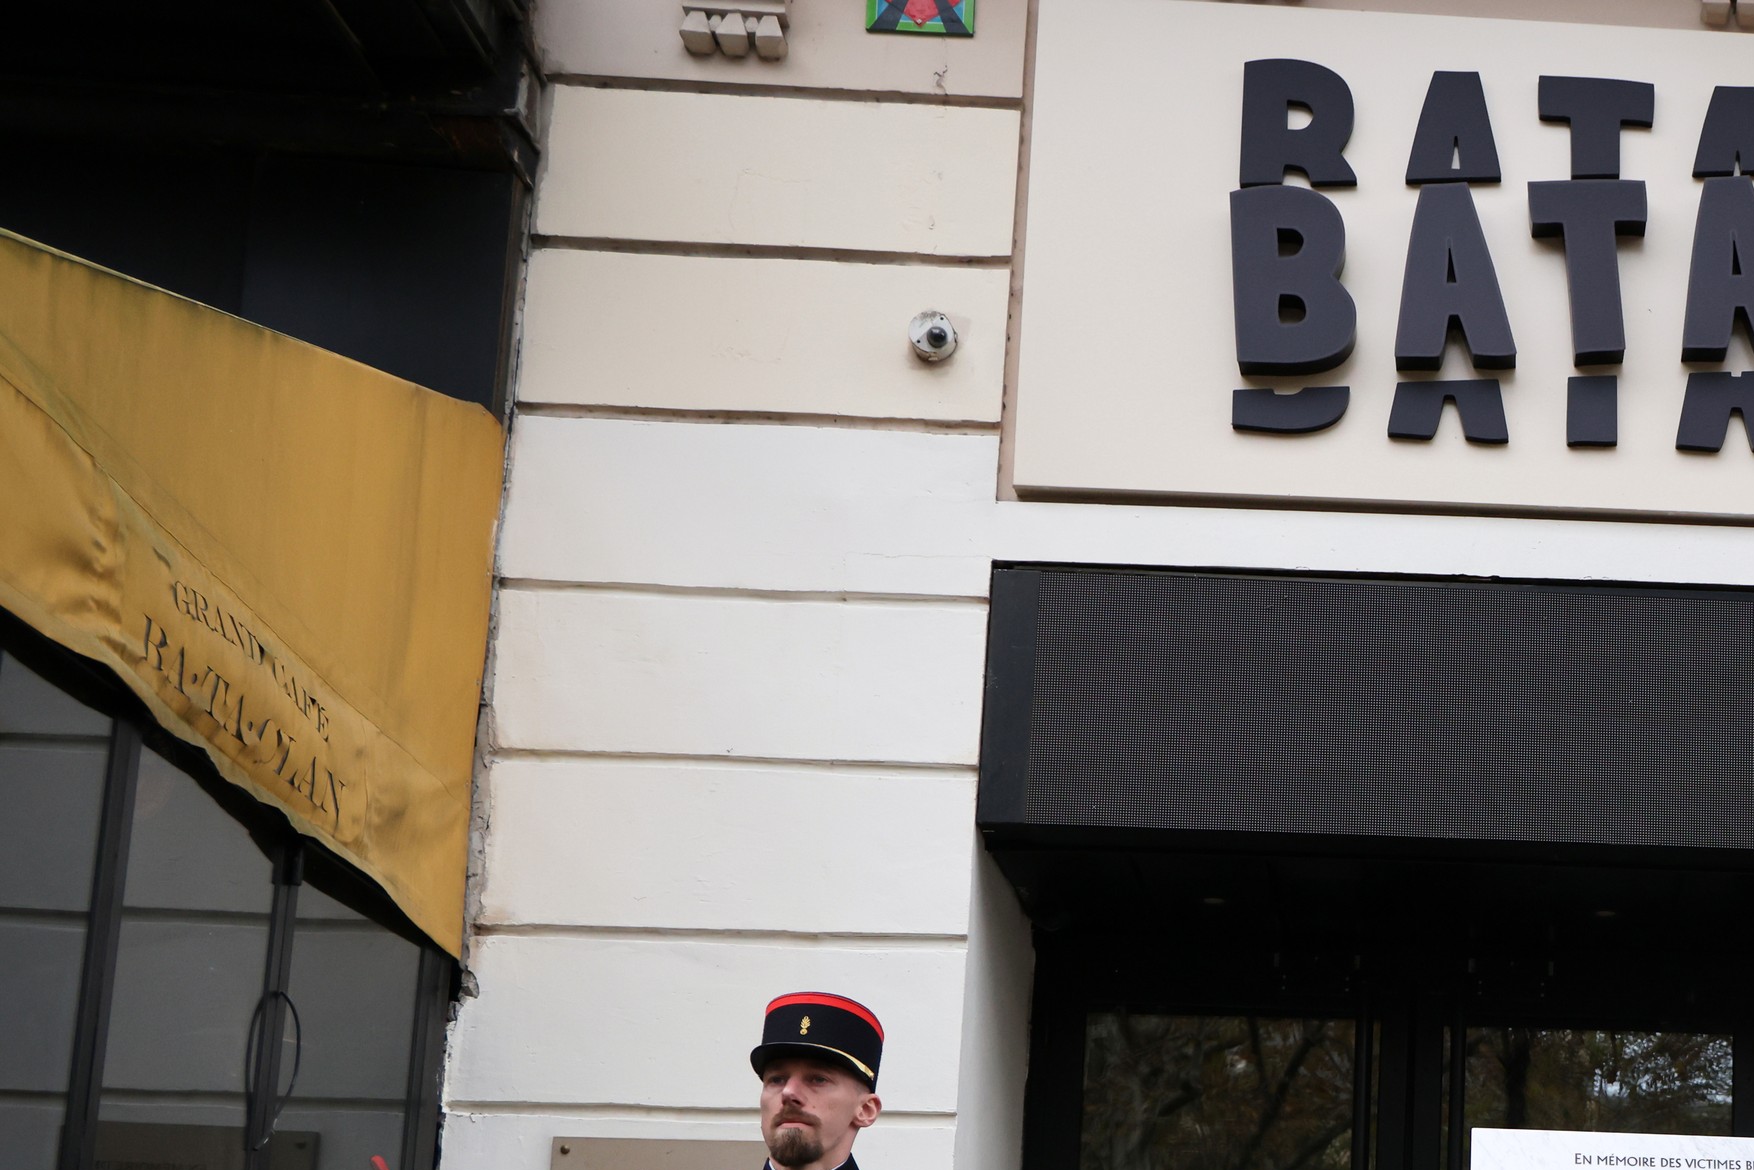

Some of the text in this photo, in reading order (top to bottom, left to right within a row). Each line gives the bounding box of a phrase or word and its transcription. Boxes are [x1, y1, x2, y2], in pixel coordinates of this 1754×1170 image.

[171, 580, 266, 666] GRAND
[1596, 1152, 1657, 1168] MÉMOIRE
[1659, 1156, 1682, 1169] DES
[1683, 1157, 1742, 1170] VICTIMES
